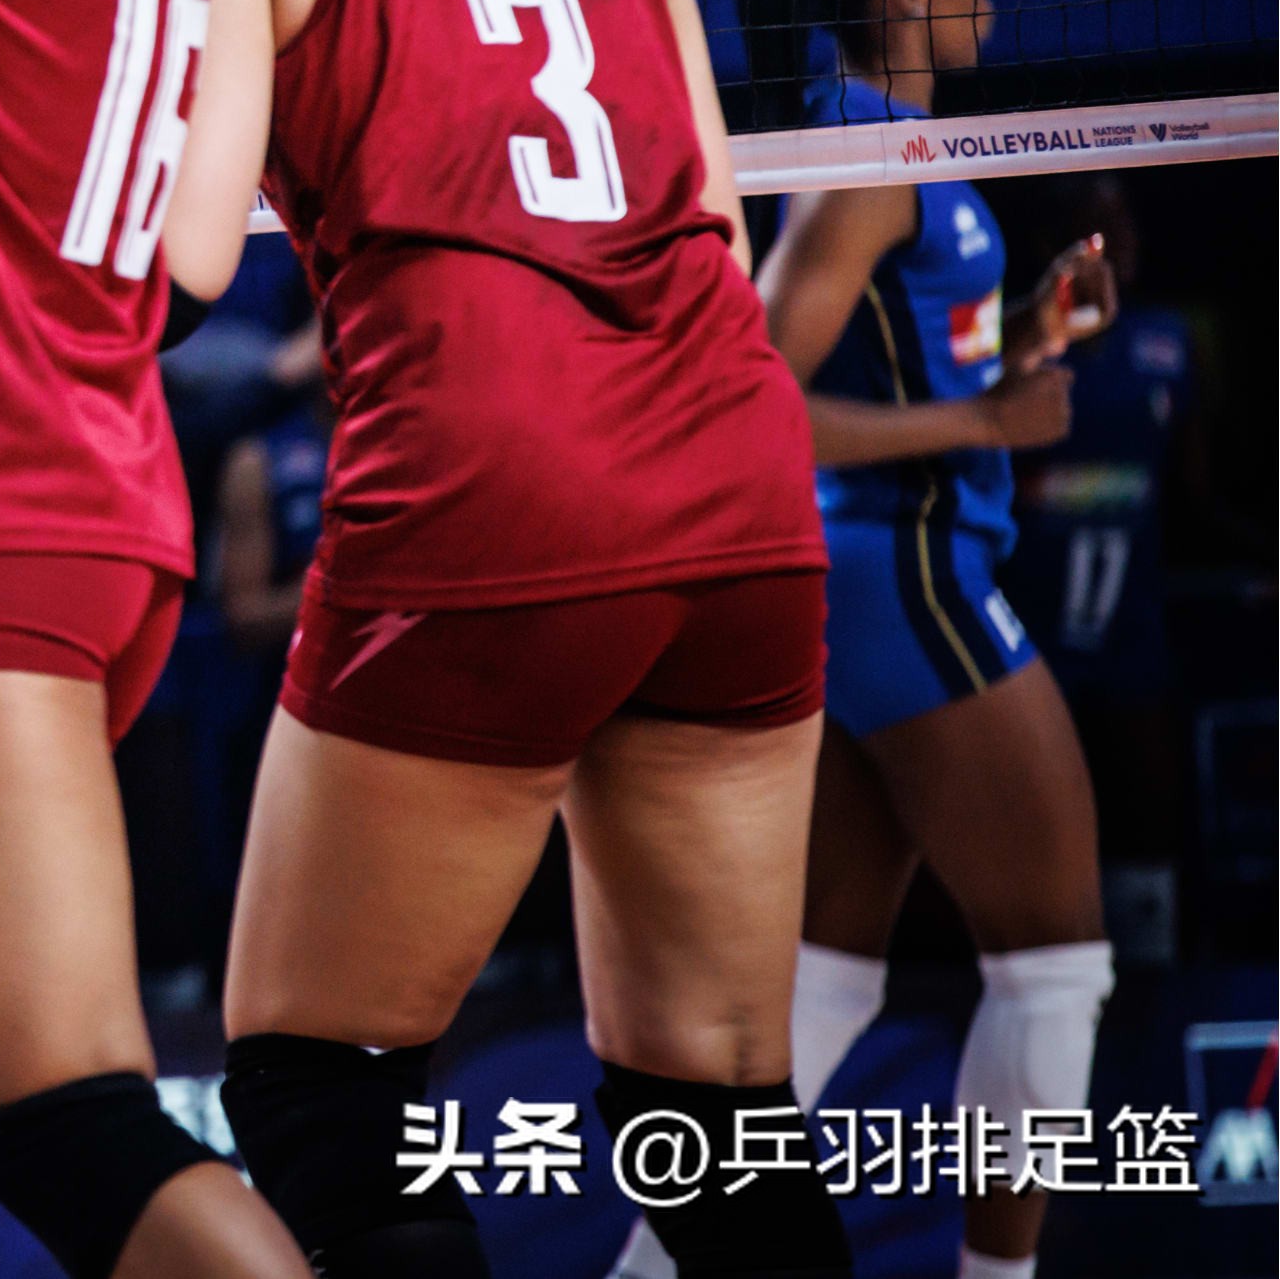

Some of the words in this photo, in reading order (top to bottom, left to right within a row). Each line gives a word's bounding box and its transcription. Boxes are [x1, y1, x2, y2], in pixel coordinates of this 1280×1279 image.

[1092, 124, 1136, 137] NATIONS
[901, 134, 937, 165] VNL
[942, 128, 1091, 159] VOLLEYBALL
[1094, 136, 1134, 148] LEAGUE
